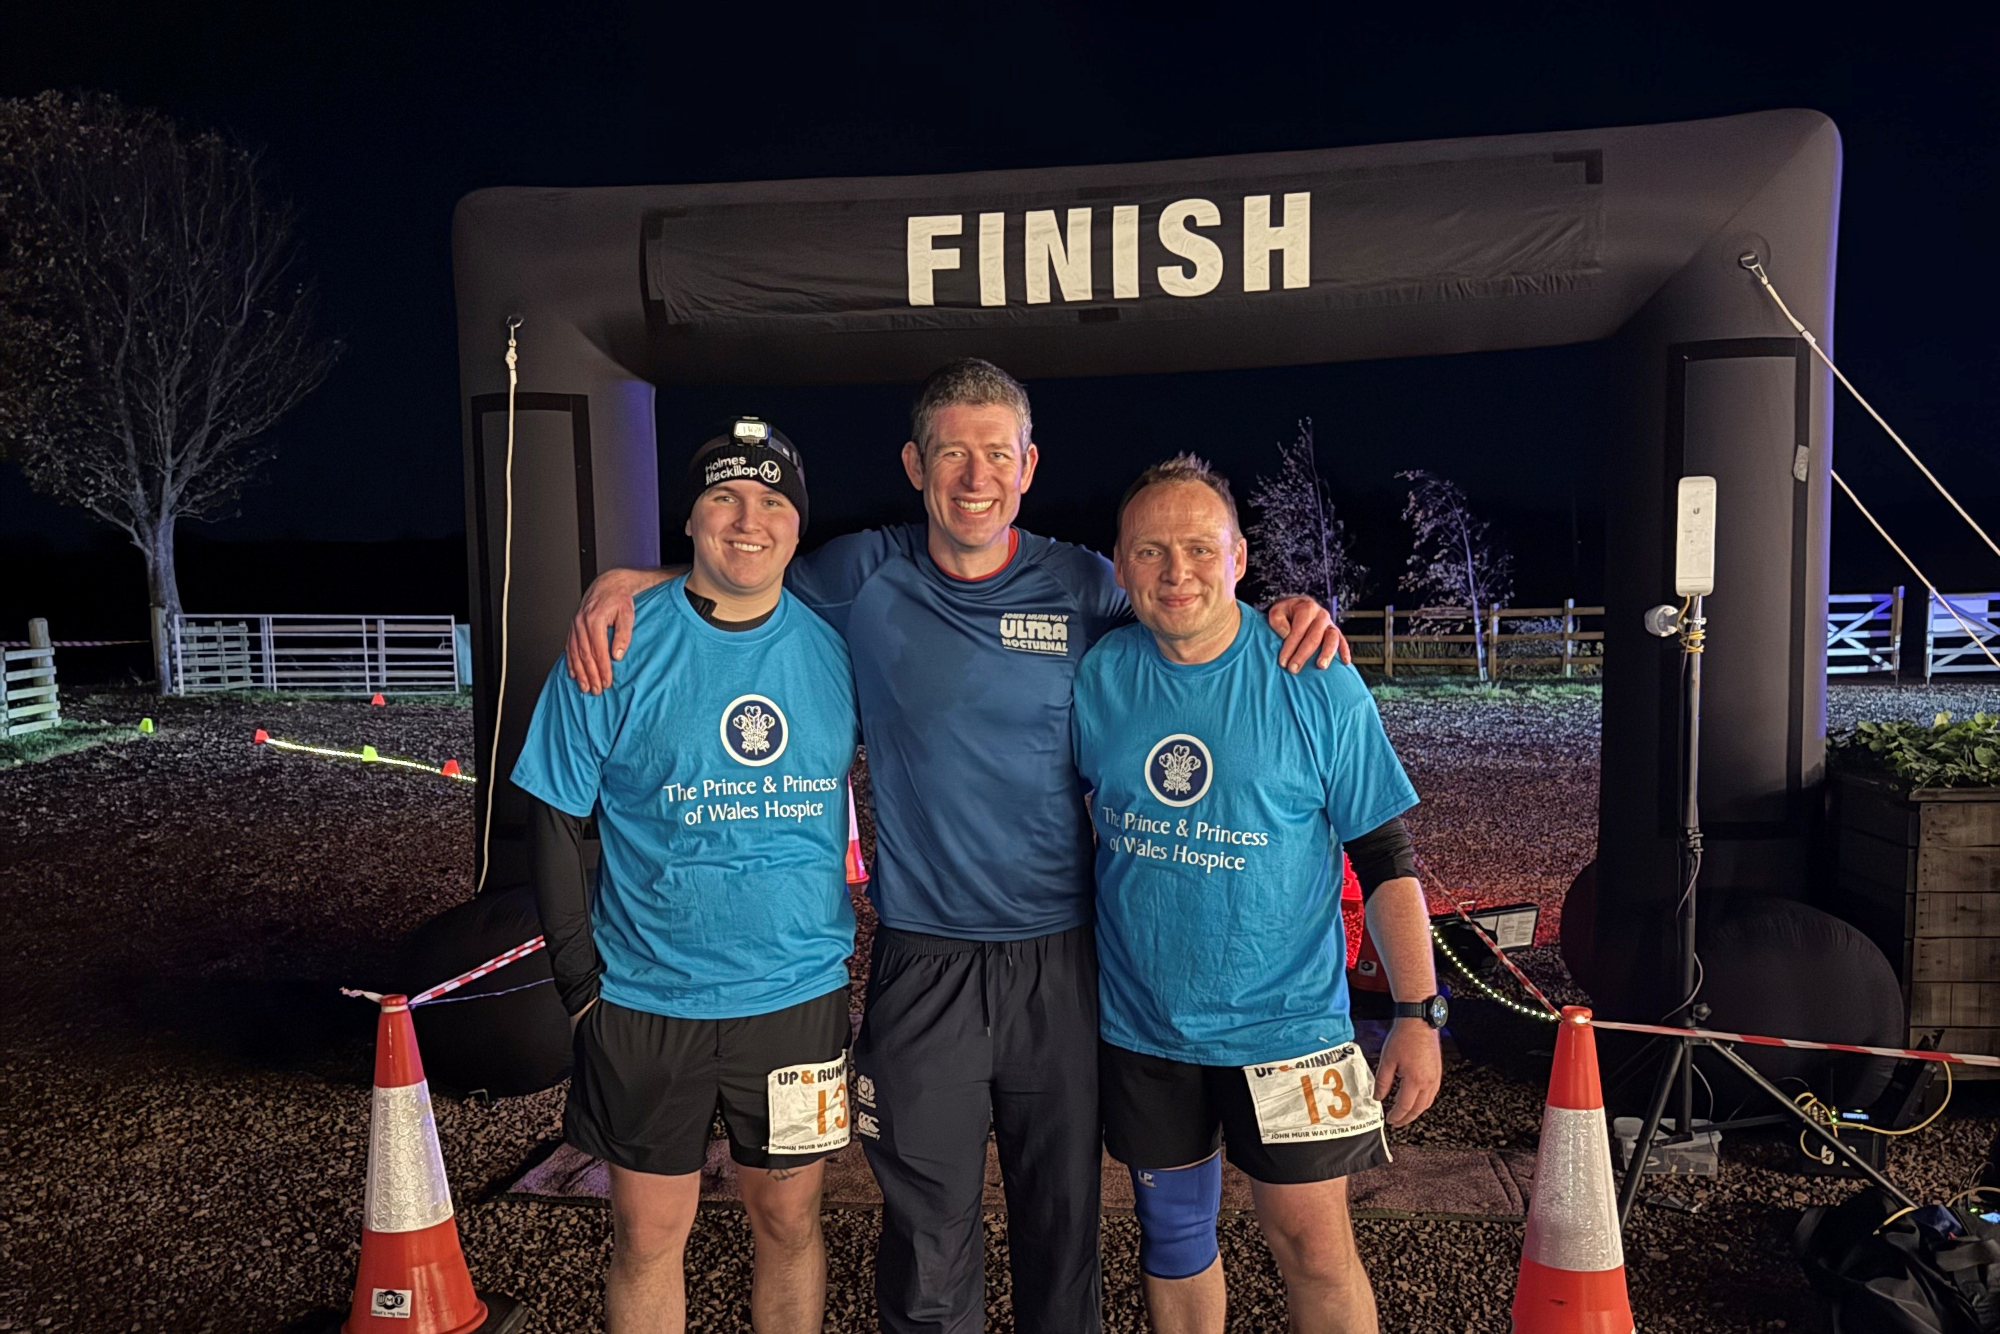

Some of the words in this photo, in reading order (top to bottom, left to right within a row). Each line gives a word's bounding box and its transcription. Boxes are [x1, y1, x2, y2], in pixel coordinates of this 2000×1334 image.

[907, 191, 1311, 307] FINISH
[705, 456, 747, 473] Holmes
[705, 465, 758, 486] Mackillop
[1001, 612, 1026, 620] JOHN
[1026, 613, 1049, 621] MUIR
[1050, 614, 1069, 623] WAY
[1000, 619, 1068, 641] ULTRA
[1001, 637, 1068, 652] NOCTURNAL
[663, 783, 697, 802] The
[702, 778, 757, 798] Prince
[762, 775, 777, 794] &
[783, 775, 837, 792] Princess
[684, 805, 704, 826] of
[708, 801, 759, 822] Wales
[765, 800, 824, 823] Hospice
[1102, 806, 1121, 827] The
[1124, 812, 1171, 835] Prince
[1175, 818, 1189, 838] &
[1195, 821, 1269, 847] Princess
[1109, 835, 1123, 853] of
[1123, 836, 1168, 860] Wales
[1172, 844, 1246, 874] Hospice
[777, 1070, 799, 1085] UP
[800, 1070, 815, 1085] &
[1300, 1068, 1352, 1125] 13
[817, 1083, 848, 1136] 13
[1270, 1132, 1290, 1140] JOHN
[1311, 1129, 1328, 1137] WAY
[1330, 1127, 1349, 1135] ULTRA
[817, 1141, 832, 1149] WAY
